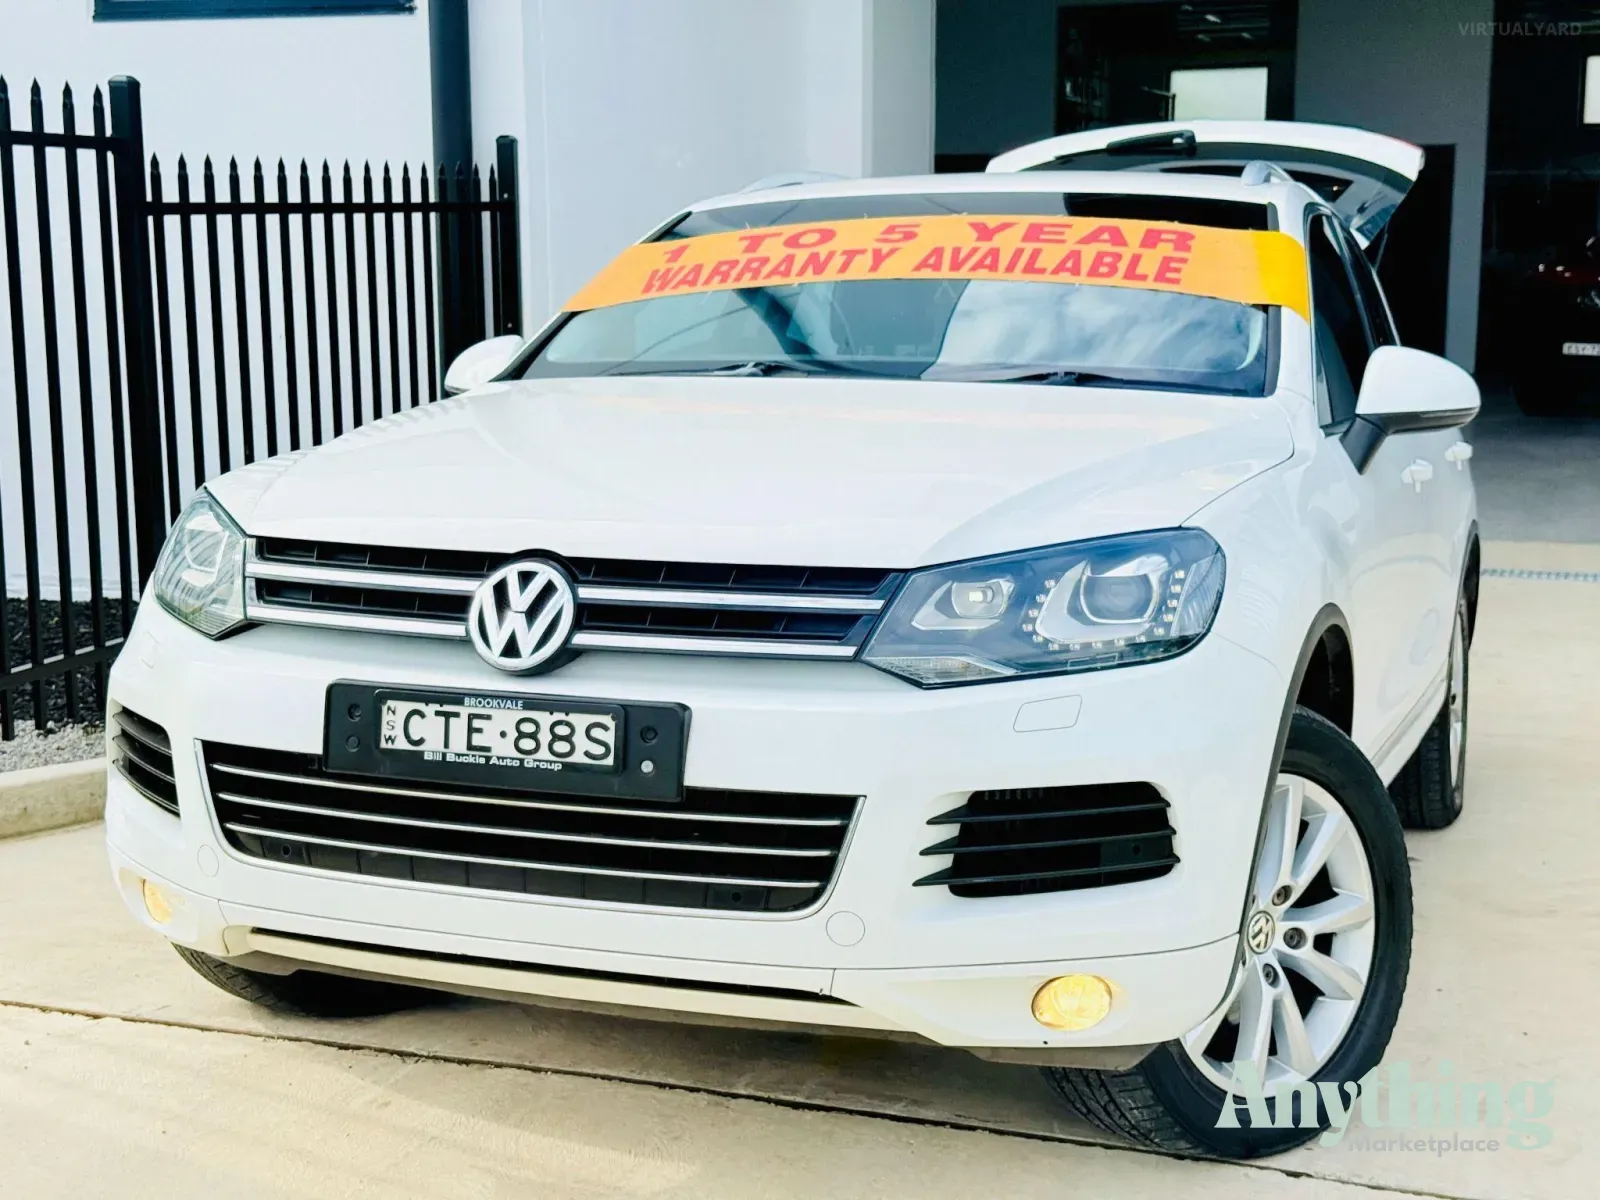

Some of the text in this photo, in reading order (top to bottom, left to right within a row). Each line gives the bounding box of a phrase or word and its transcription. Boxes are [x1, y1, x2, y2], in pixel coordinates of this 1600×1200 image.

[663, 221, 1196, 264] 1 TO 5 YEAR
[640, 246, 1189, 295] WARRANTY AVAILABLE
[474, 565, 568, 664] VW
[464, 697, 524, 711] BROOKVALE
[423, 751, 563, 772] Bill Buckle Auto Group
